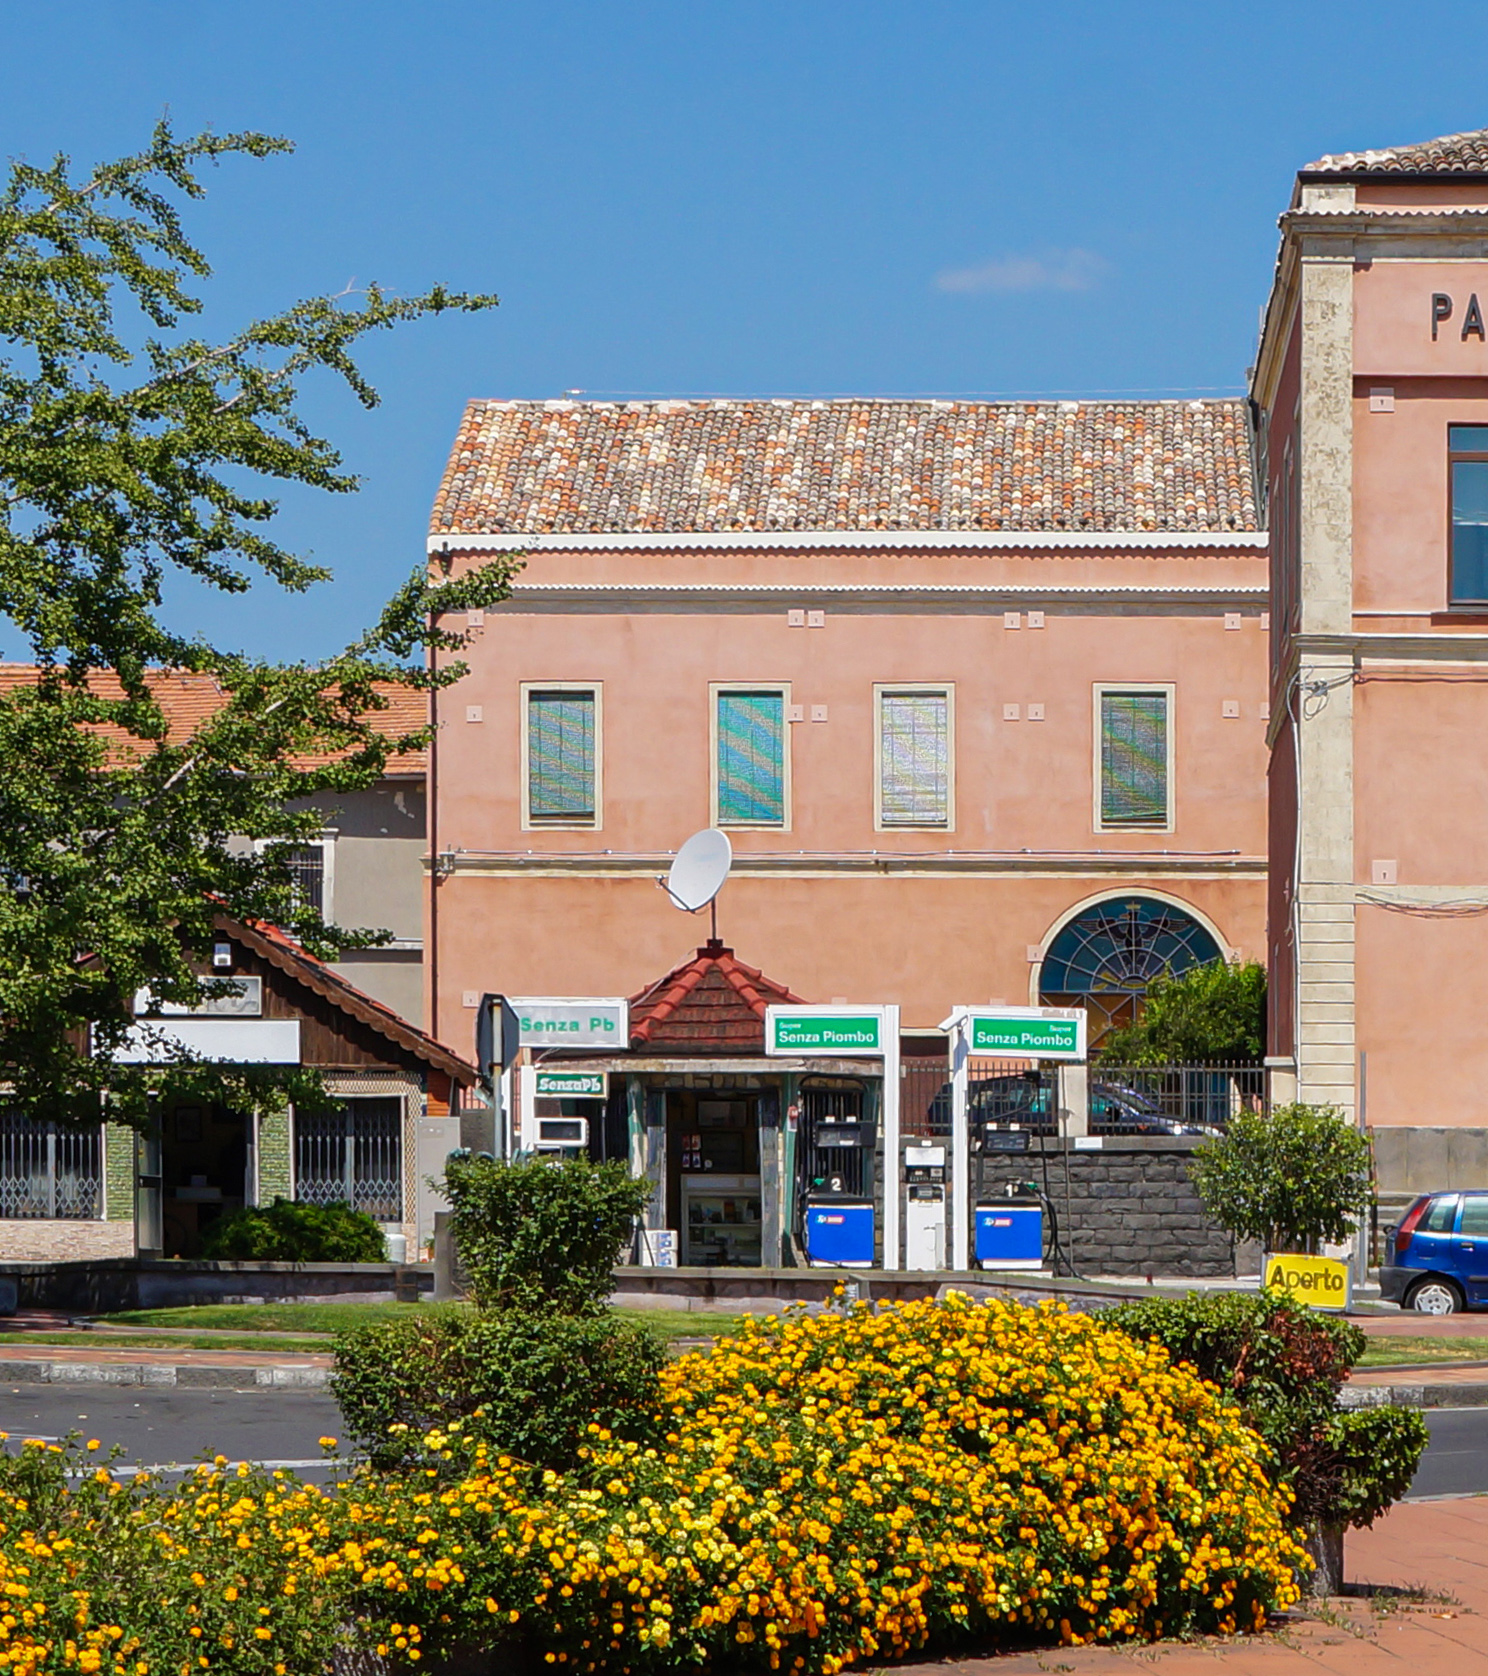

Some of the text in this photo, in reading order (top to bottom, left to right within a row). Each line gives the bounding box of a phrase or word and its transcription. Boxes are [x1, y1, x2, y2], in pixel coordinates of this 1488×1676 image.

[520, 1017, 615, 1032] Senza Pb
[779, 1030, 875, 1043] Senza Piombo
[976, 1031, 1073, 1046] Senza Piombo
[830, 1177, 842, 1192] 2
[1005, 1184, 1013, 1198] 1
[1270, 1264, 1345, 1294] Aperto
